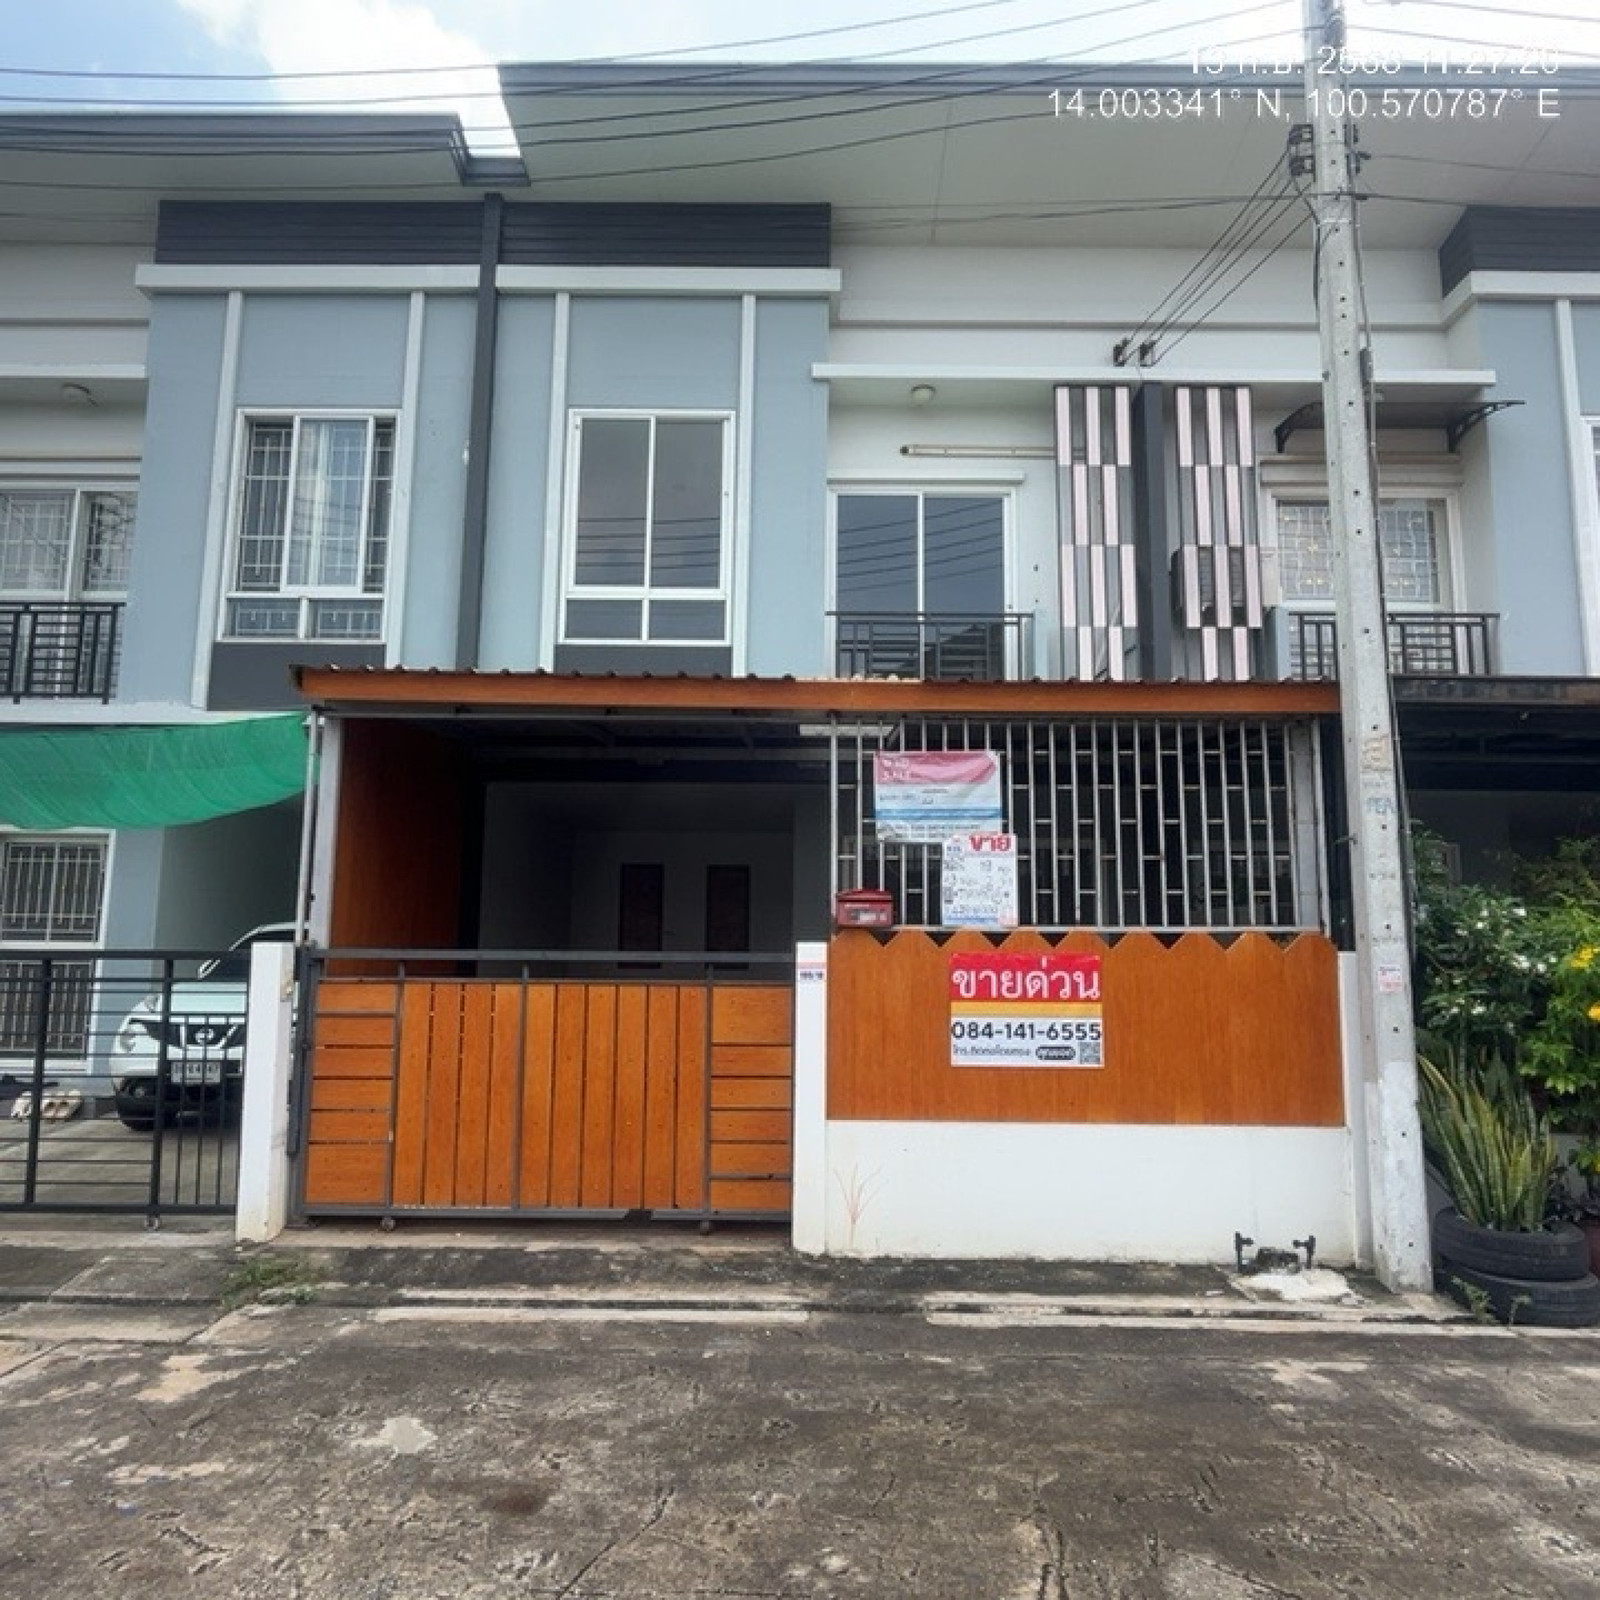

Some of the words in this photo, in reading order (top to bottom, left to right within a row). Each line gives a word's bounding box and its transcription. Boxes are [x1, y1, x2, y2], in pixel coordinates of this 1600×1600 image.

[969, 834, 1010, 851] ขาย
[951, 955, 1101, 1000] ขายด่วน
[951, 1021, 1102, 1041] 084-141-6555
